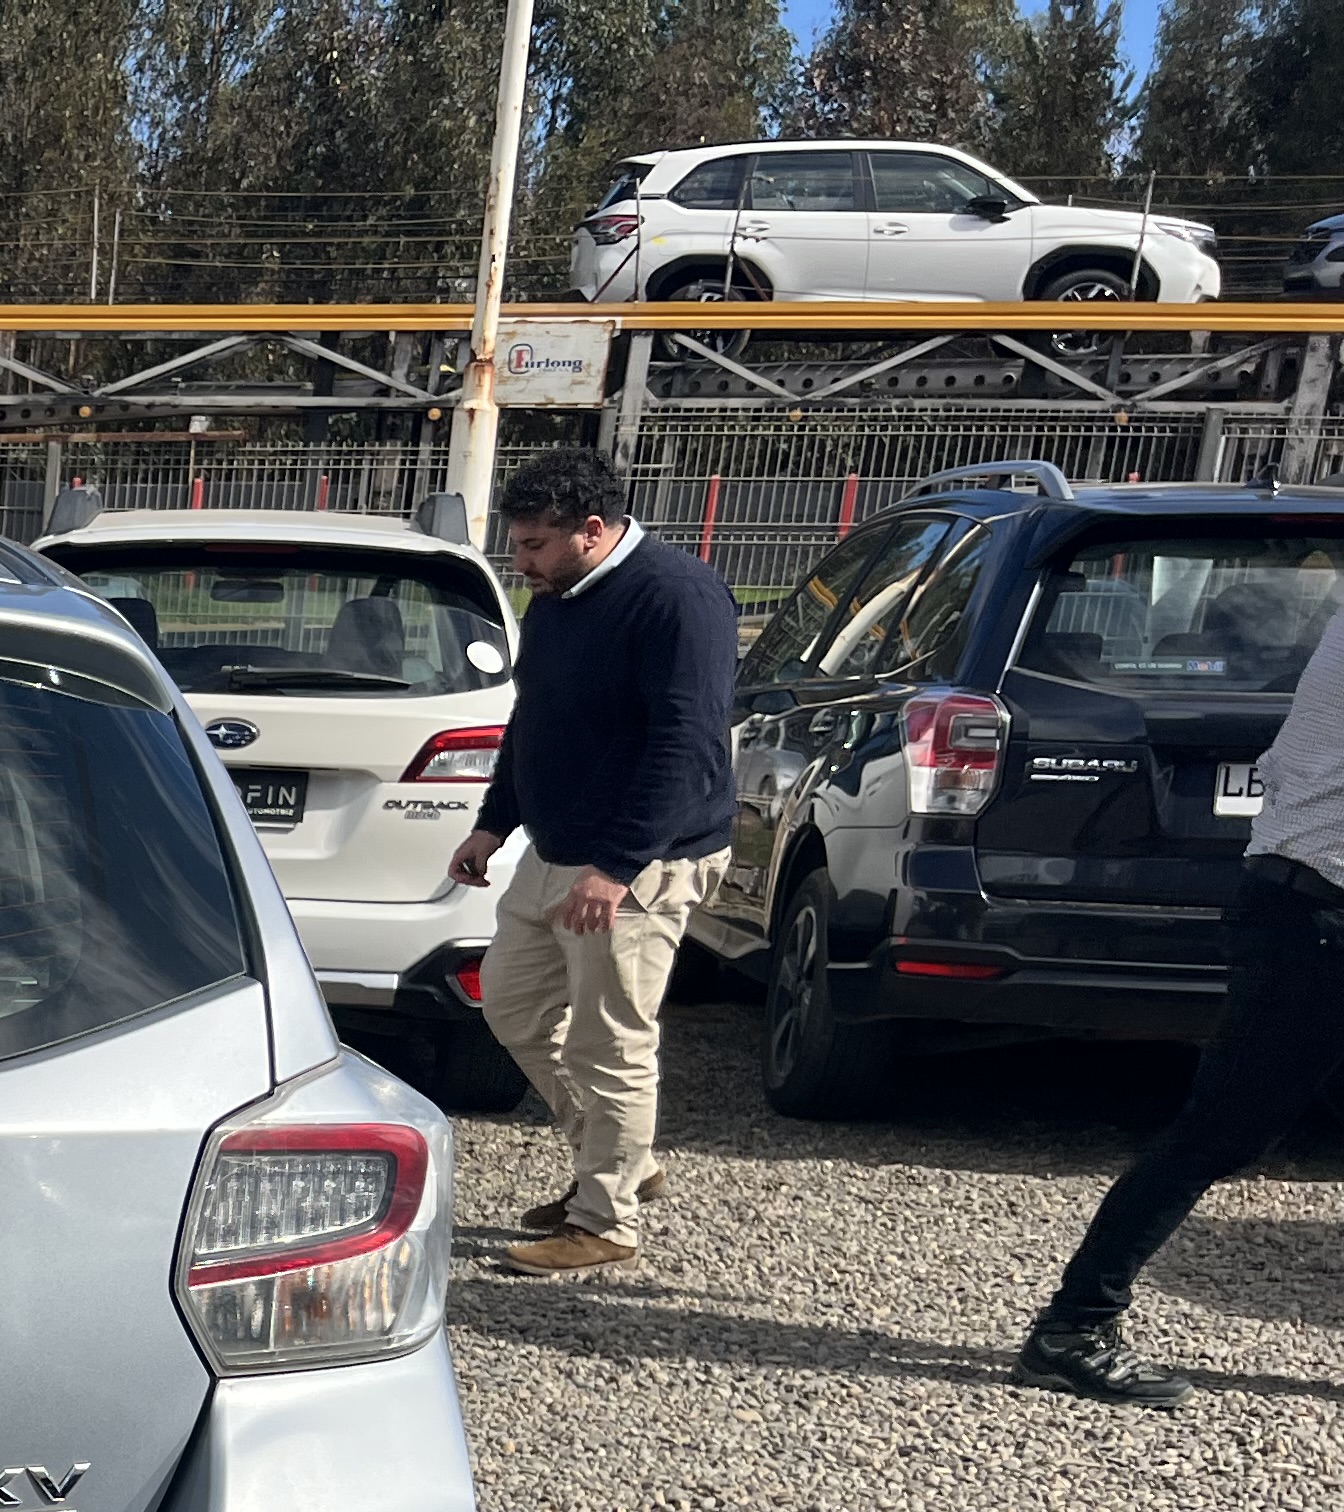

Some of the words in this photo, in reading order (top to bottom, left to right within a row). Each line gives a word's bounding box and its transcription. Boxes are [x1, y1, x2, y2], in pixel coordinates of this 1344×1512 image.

[1032, 757, 1138, 773] SUBARU
[234, 784, 296, 805] FIN
[382, 800, 469, 811] OUTBACK
